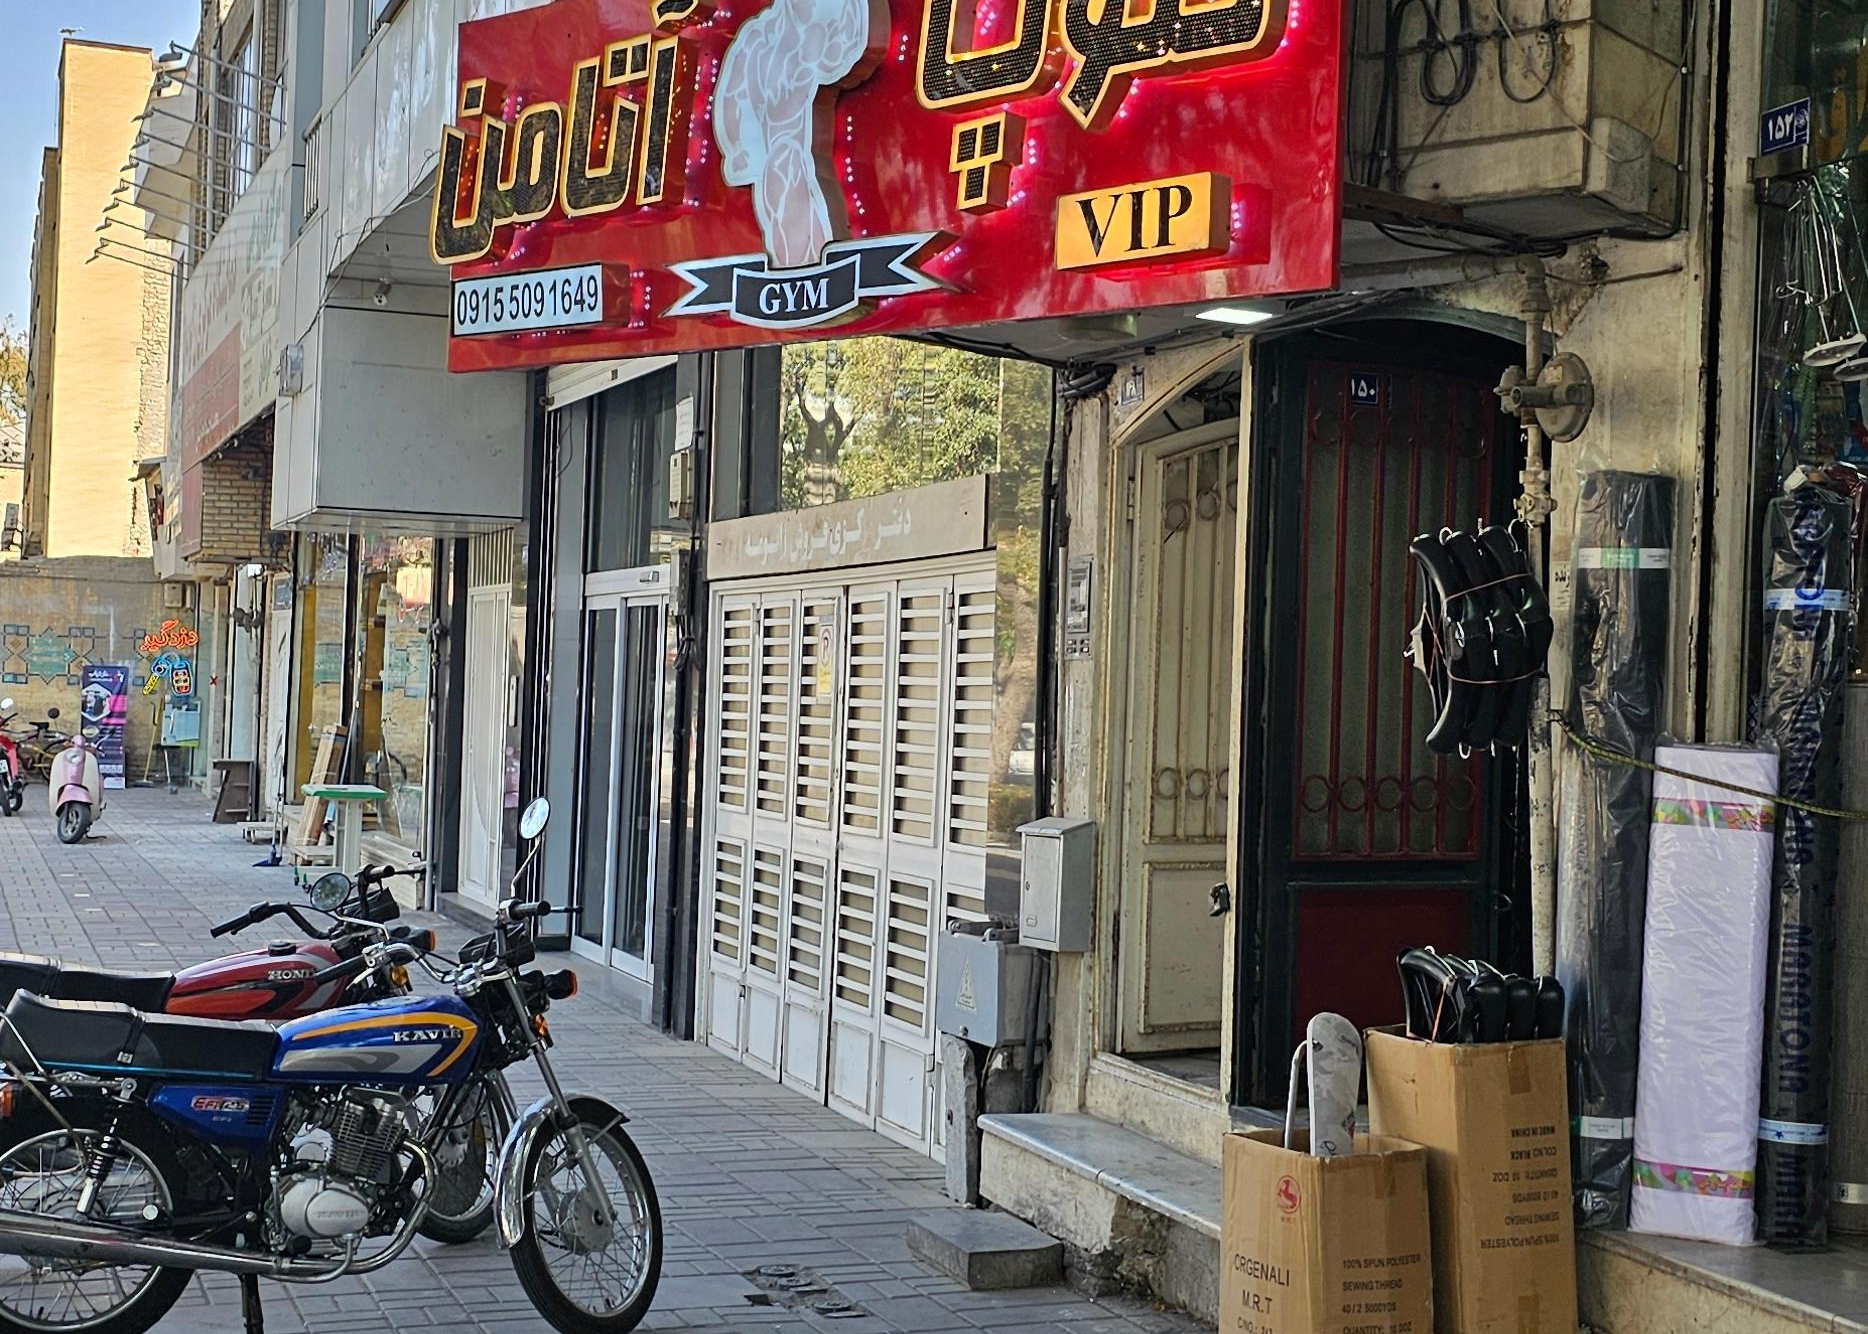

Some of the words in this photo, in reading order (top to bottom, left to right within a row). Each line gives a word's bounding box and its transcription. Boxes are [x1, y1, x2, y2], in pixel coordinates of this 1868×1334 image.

[1768, 112, 1794, 142] ۱۵۲
[1077, 184, 1193, 257] VIP
[759, 277, 830, 315] GYM
[1351, 378, 1376, 397] ۱۵۰
[140, 618, 199, 652] دزدگیر
[268, 969, 315, 980] HOND
[1777, 923, 1814, 1095] MARATONA
[393, 1028, 462, 1042] KAVIR
[1480, 1236, 1525, 1249] POLYESTER
[1234, 1253, 1290, 1287] ORGENALI
[1342, 1258, 1362, 1270] 100%
[1363, 1257, 1385, 1269] SPUN
[1386, 1253, 1422, 1267] POLYESTER
[1342, 1280, 1374, 1292] SEWING
[1375, 1277, 1403, 1290] THREAD
[1242, 1289, 1273, 1315] M.R.T
